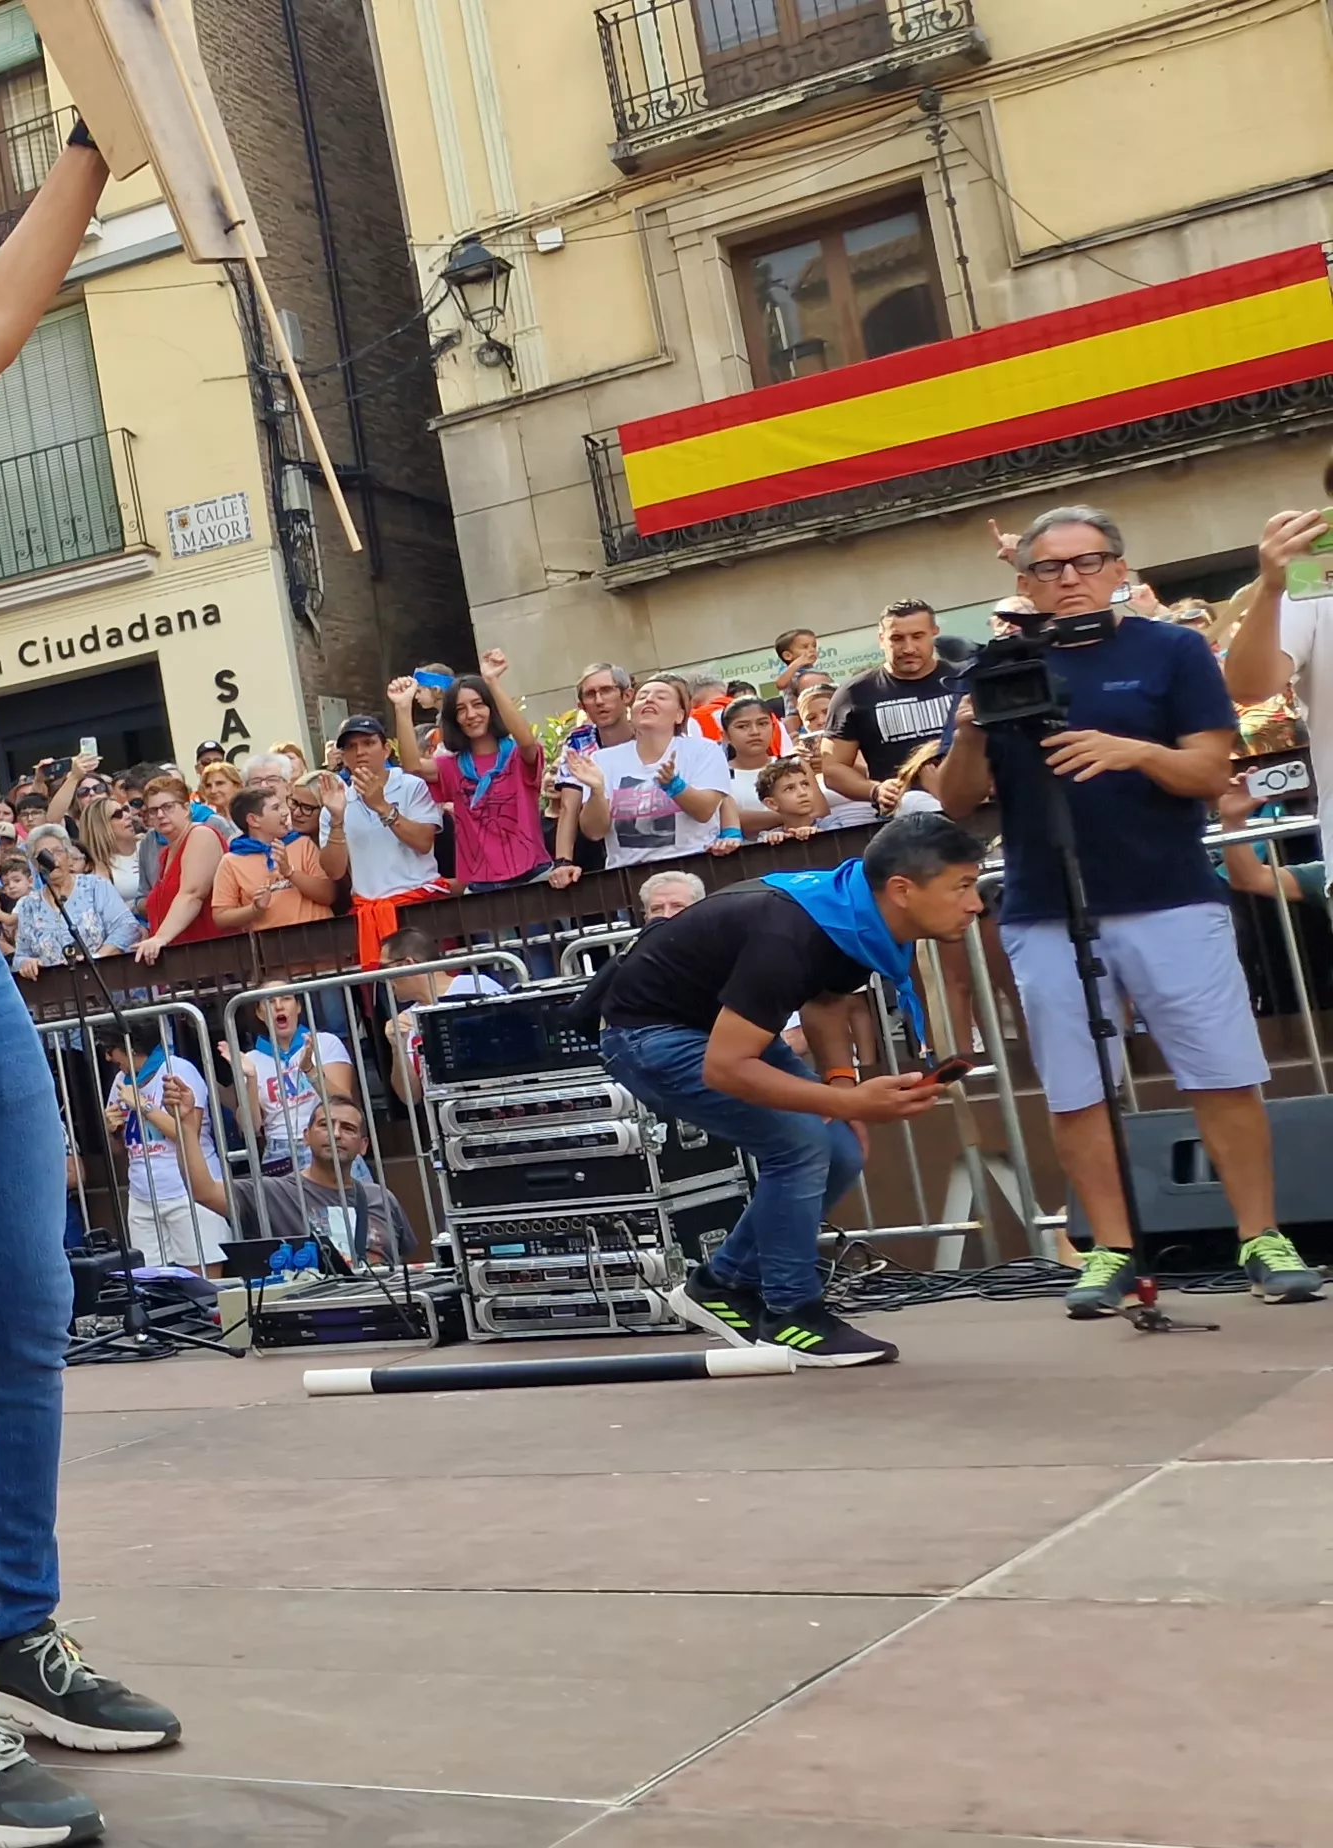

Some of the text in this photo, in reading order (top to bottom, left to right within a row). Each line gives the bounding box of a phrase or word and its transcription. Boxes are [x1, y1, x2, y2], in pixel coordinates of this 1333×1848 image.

[196, 500, 239, 524] CALLE
[181, 520, 242, 549] MAYOR
[18, 603, 222, 668] Ciudadana
